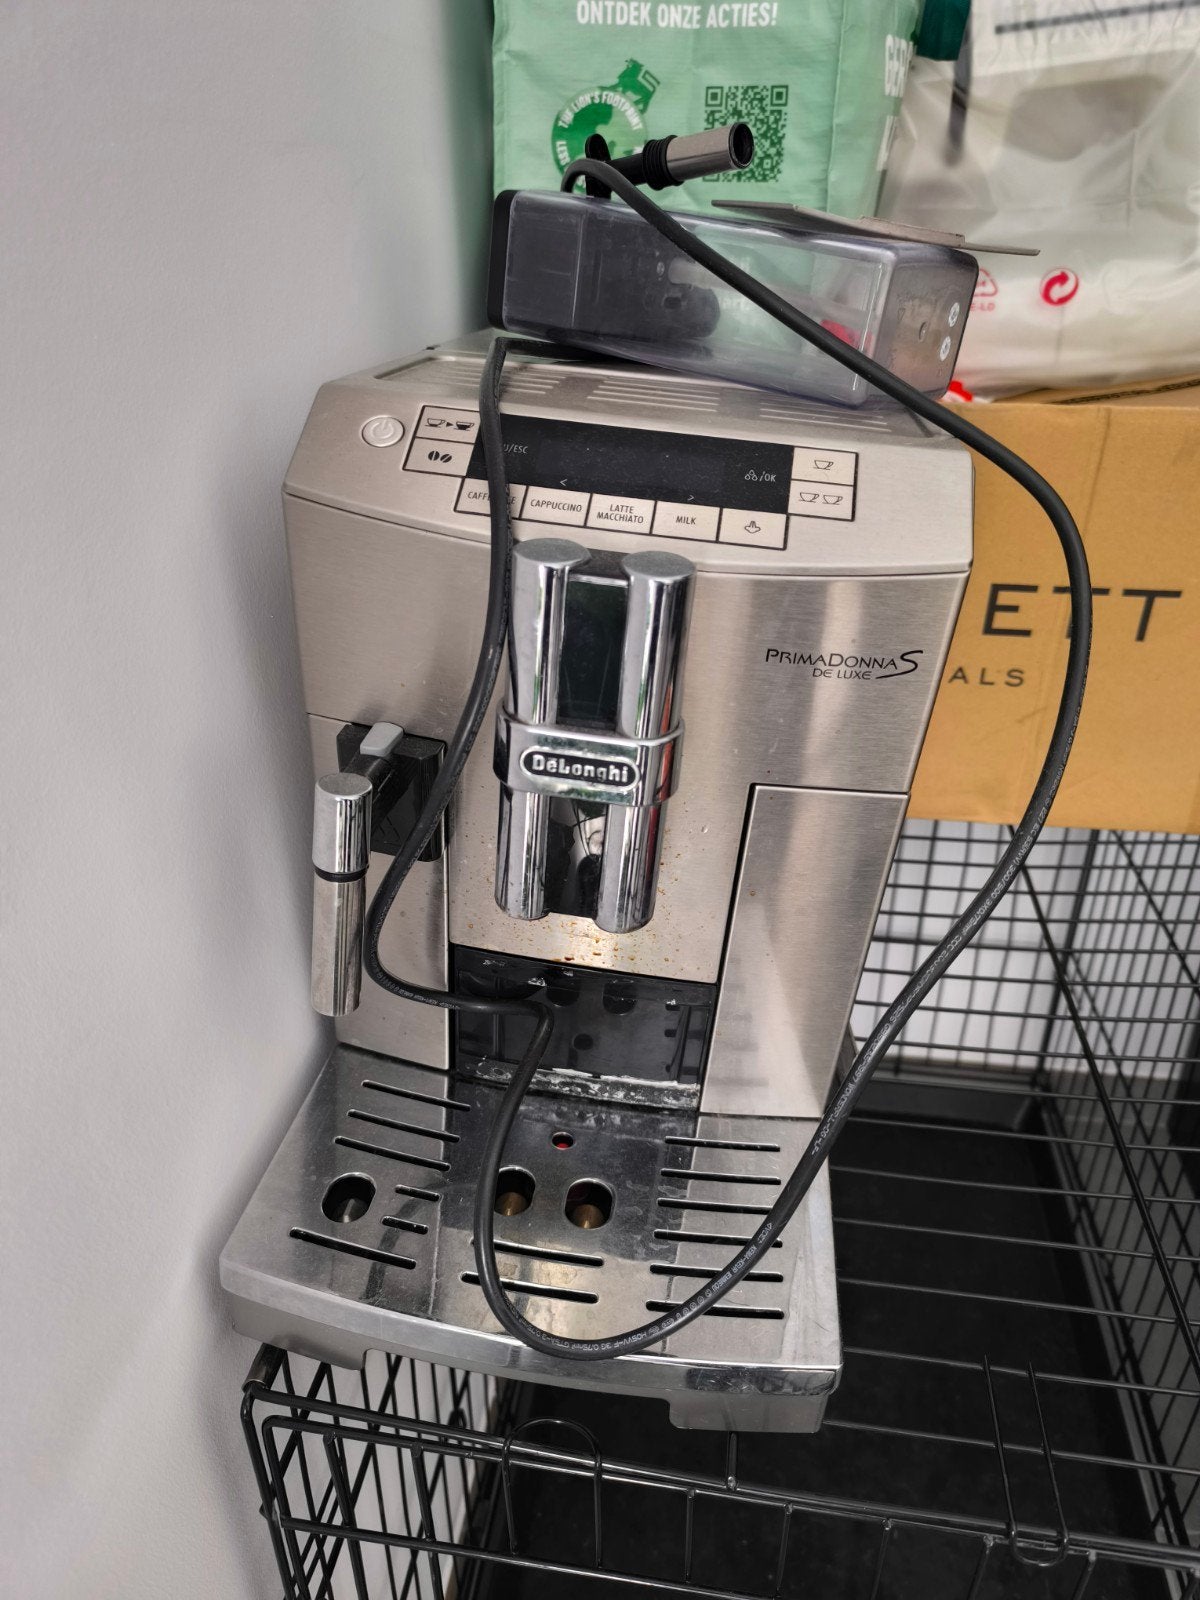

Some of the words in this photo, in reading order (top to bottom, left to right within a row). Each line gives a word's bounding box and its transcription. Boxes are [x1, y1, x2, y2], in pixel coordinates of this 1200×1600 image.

[577, 0, 651, 26] ONTDEK
[657, 3, 701, 29] ONZE
[706, 2, 778, 28] ACTIES!
[530, 498, 583, 513] CAPPUCCINO
[609, 503, 635, 514] LATTE
[597, 511, 644, 524] MACCHIATO
[676, 515, 697, 526] MILK
[812, 668, 833, 678] DE
[837, 670, 872, 680] LUXE
